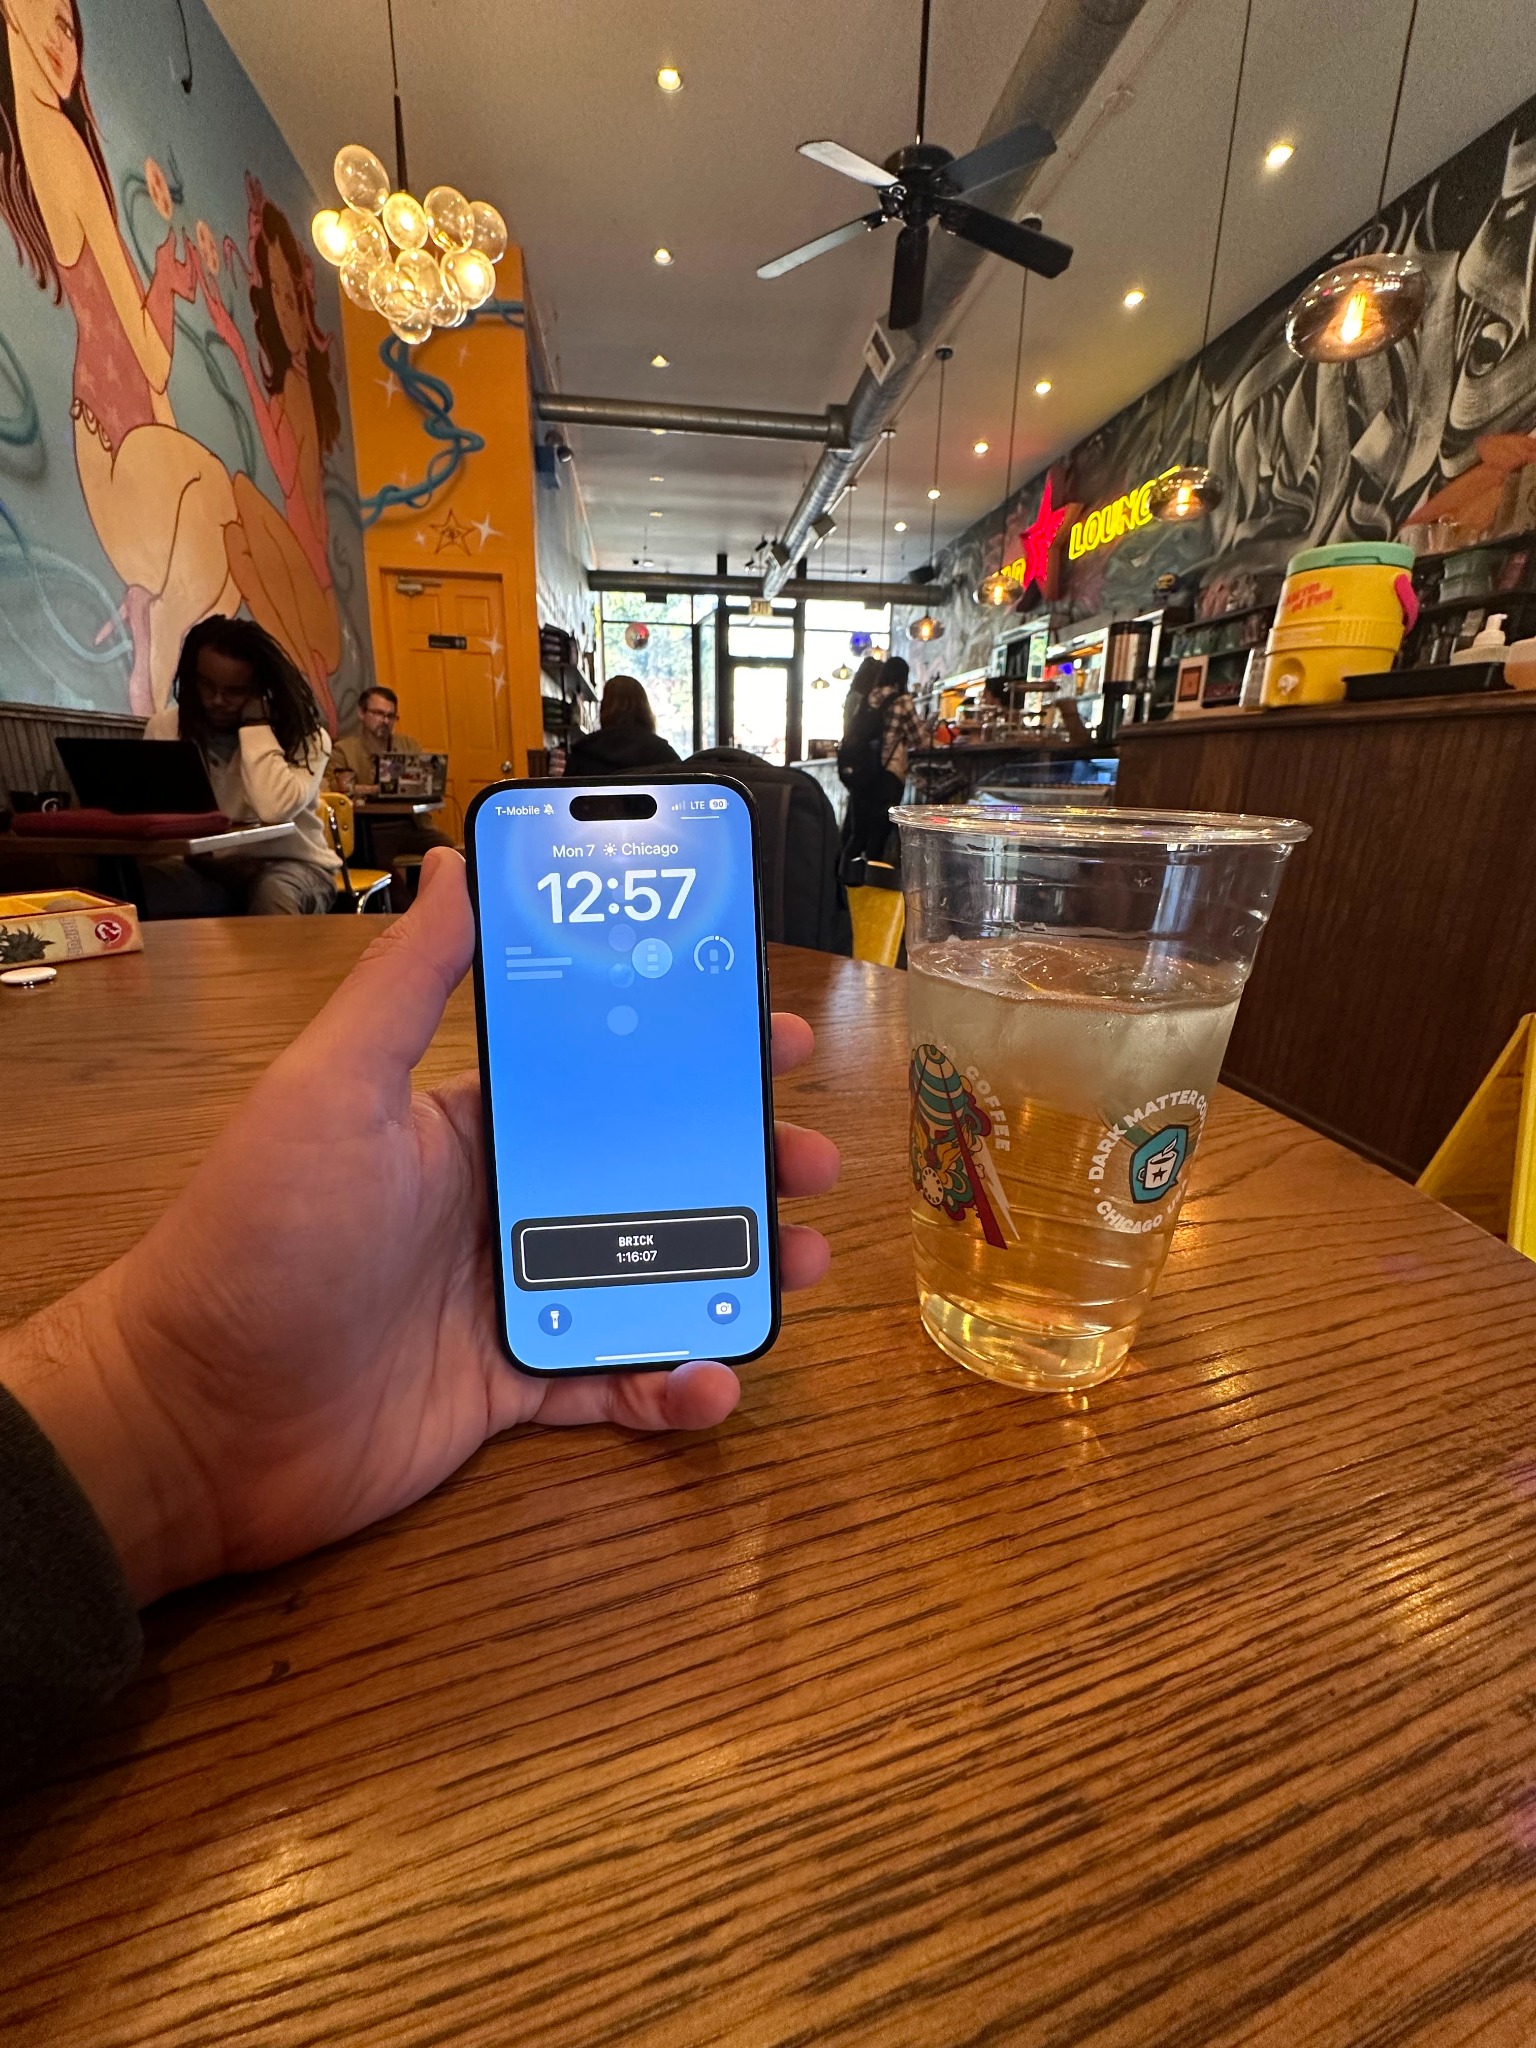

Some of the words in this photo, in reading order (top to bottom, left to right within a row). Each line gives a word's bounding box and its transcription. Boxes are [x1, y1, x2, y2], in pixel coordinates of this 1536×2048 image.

[495, 805, 540, 816] T-Mobile
[690, 801, 705, 810] LTE
[712, 800, 724, 808] 90
[552, 845, 583, 857] Mon
[586, 844, 595, 857] 7
[622, 842, 679, 857] Chicago
[537, 868, 696, 923] 12:57
[965, 1065, 1011, 1152] COFFEE
[1088, 1123, 1128, 1180] DARK
[1123, 1089, 1199, 1128] MATTER
[1096, 1200, 1164, 1234] CHICAGO
[618, 1235, 654, 1247] BRICK
[616, 1250, 658, 1263] 1:16:07
